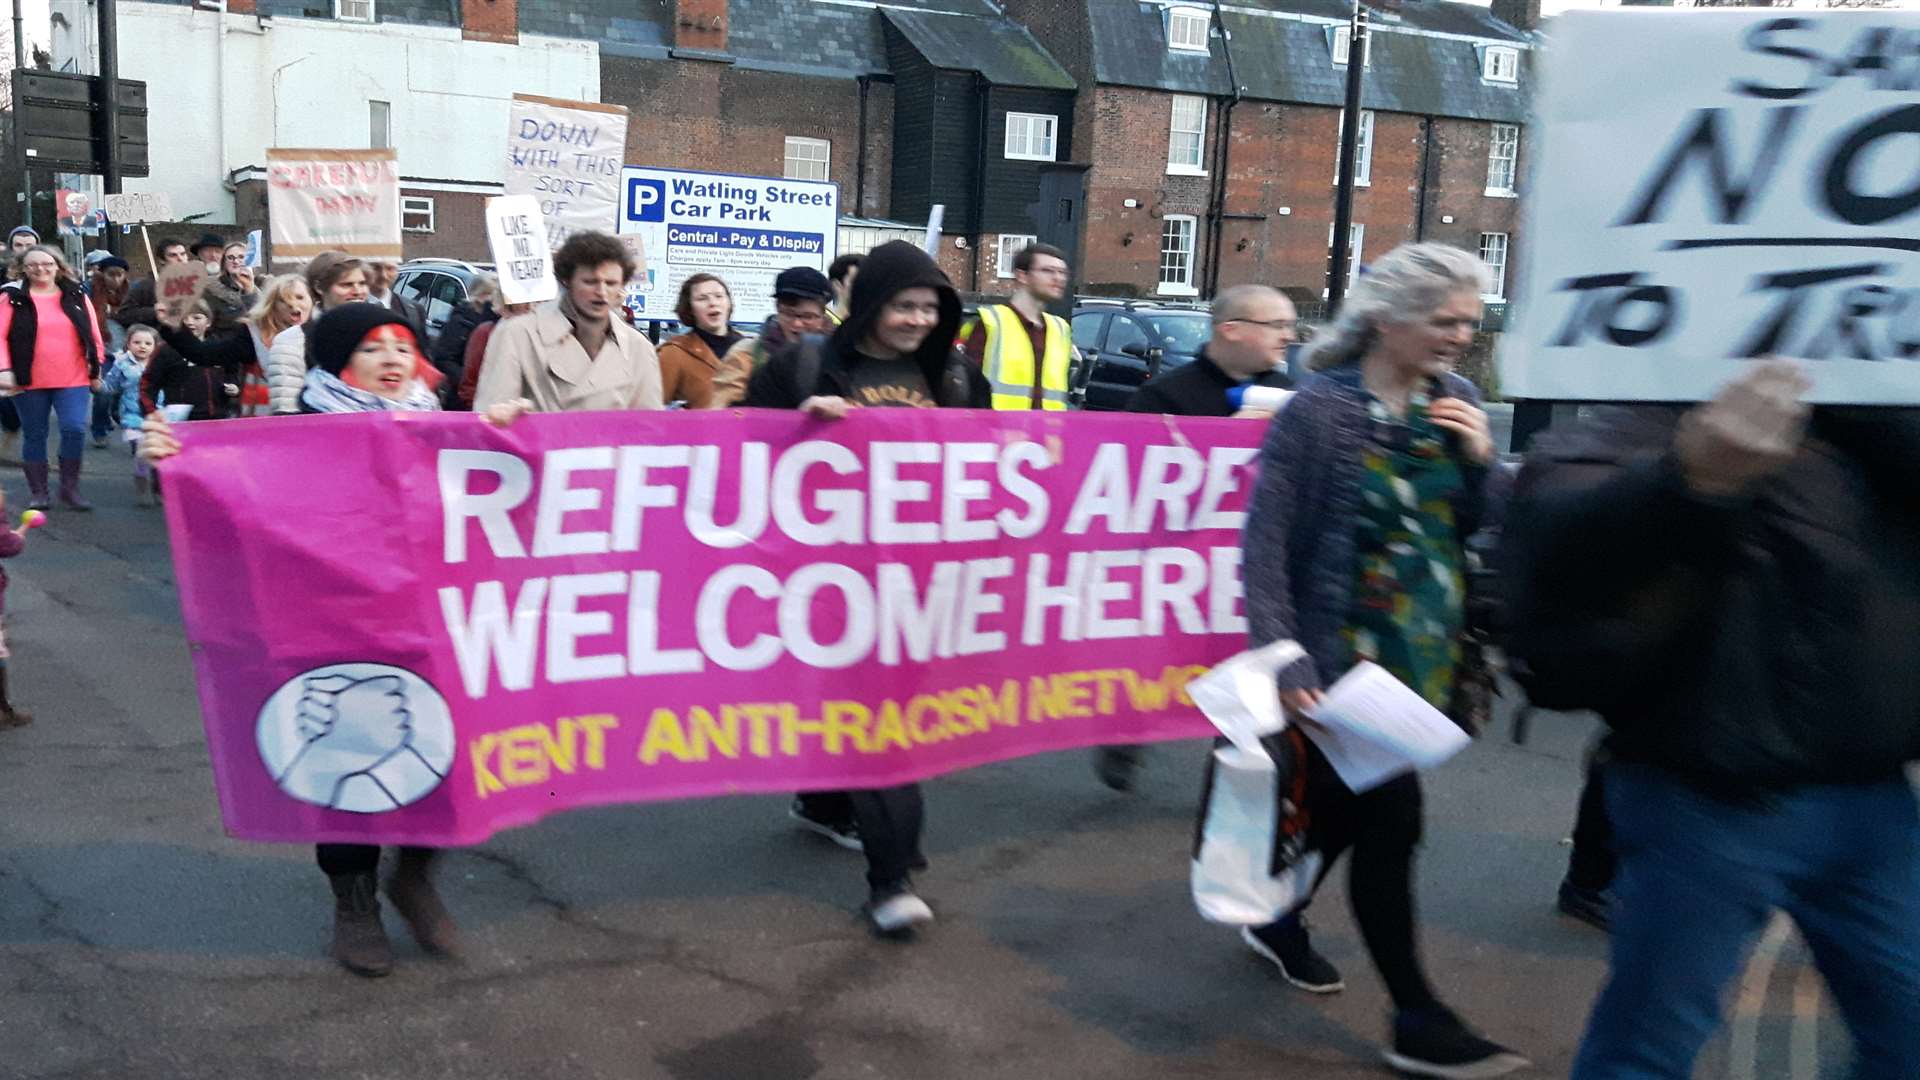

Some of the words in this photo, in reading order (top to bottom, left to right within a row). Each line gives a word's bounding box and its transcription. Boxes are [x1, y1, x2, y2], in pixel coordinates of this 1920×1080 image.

[1730, 17, 1920, 99] SA
[519, 119, 599, 147] DOWN
[511, 146, 560, 167] WITH
[573, 152, 618, 177] THIS
[1606, 104, 1920, 226] NO
[535, 175, 594, 197] SORT
[634, 184, 659, 215] P
[672, 178, 757, 205] Watling
[766, 186, 832, 207] Street
[541, 200, 569, 216] OF
[670, 199, 711, 218] Car
[720, 202, 772, 222] Park
[668, 229, 719, 245] Central
[730, 232, 756, 249] Pay
[759, 235, 769, 247] &
[773, 237, 821, 254] Display
[1546, 271, 1682, 347] TO
[438, 439, 1053, 563] REFUGEES
[1063, 442, 1260, 535] ARE
[438, 556, 1014, 700] WELCOME
[1020, 546, 1249, 646] HERE
[469, 712, 620, 799] KENT
[637, 678, 1019, 766] ANTI-RACISM
[1027, 664, 1211, 722] NETWO
